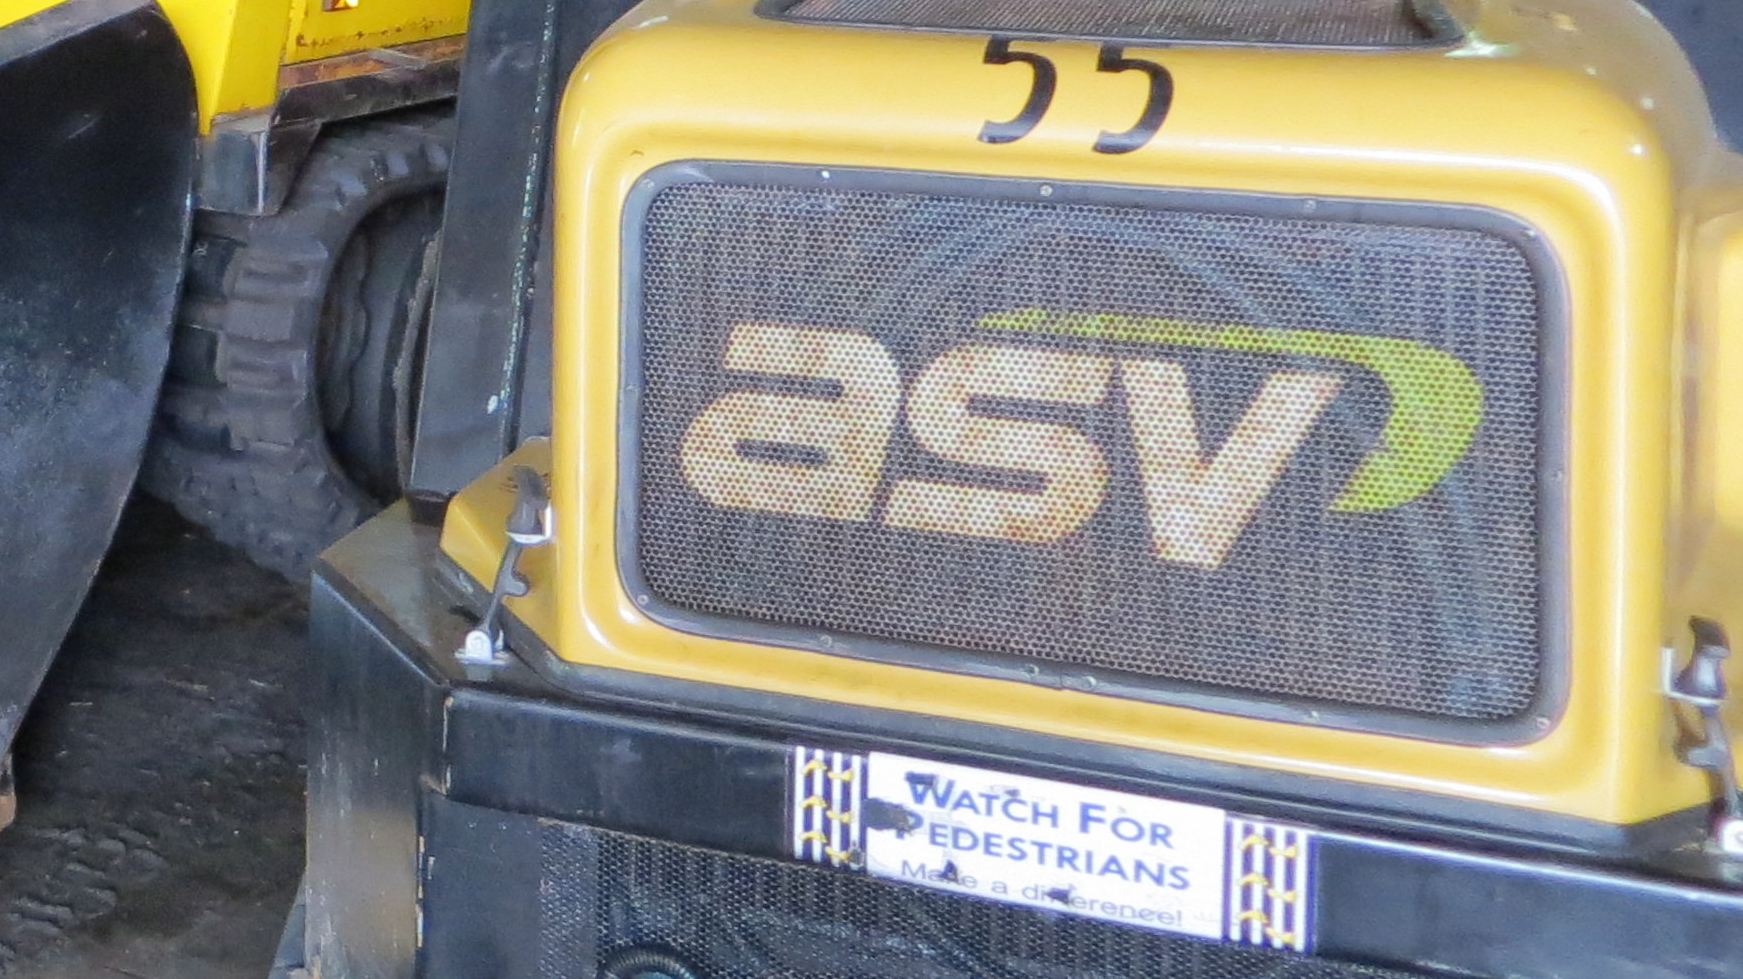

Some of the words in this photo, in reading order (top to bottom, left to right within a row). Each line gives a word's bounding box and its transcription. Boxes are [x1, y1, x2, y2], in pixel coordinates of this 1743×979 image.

[977, 34, 1175, 155] 55
[903, 770, 1060, 829] WATCH
[1077, 801, 1176, 850] FOR
[990, 879, 1009, 896] a
